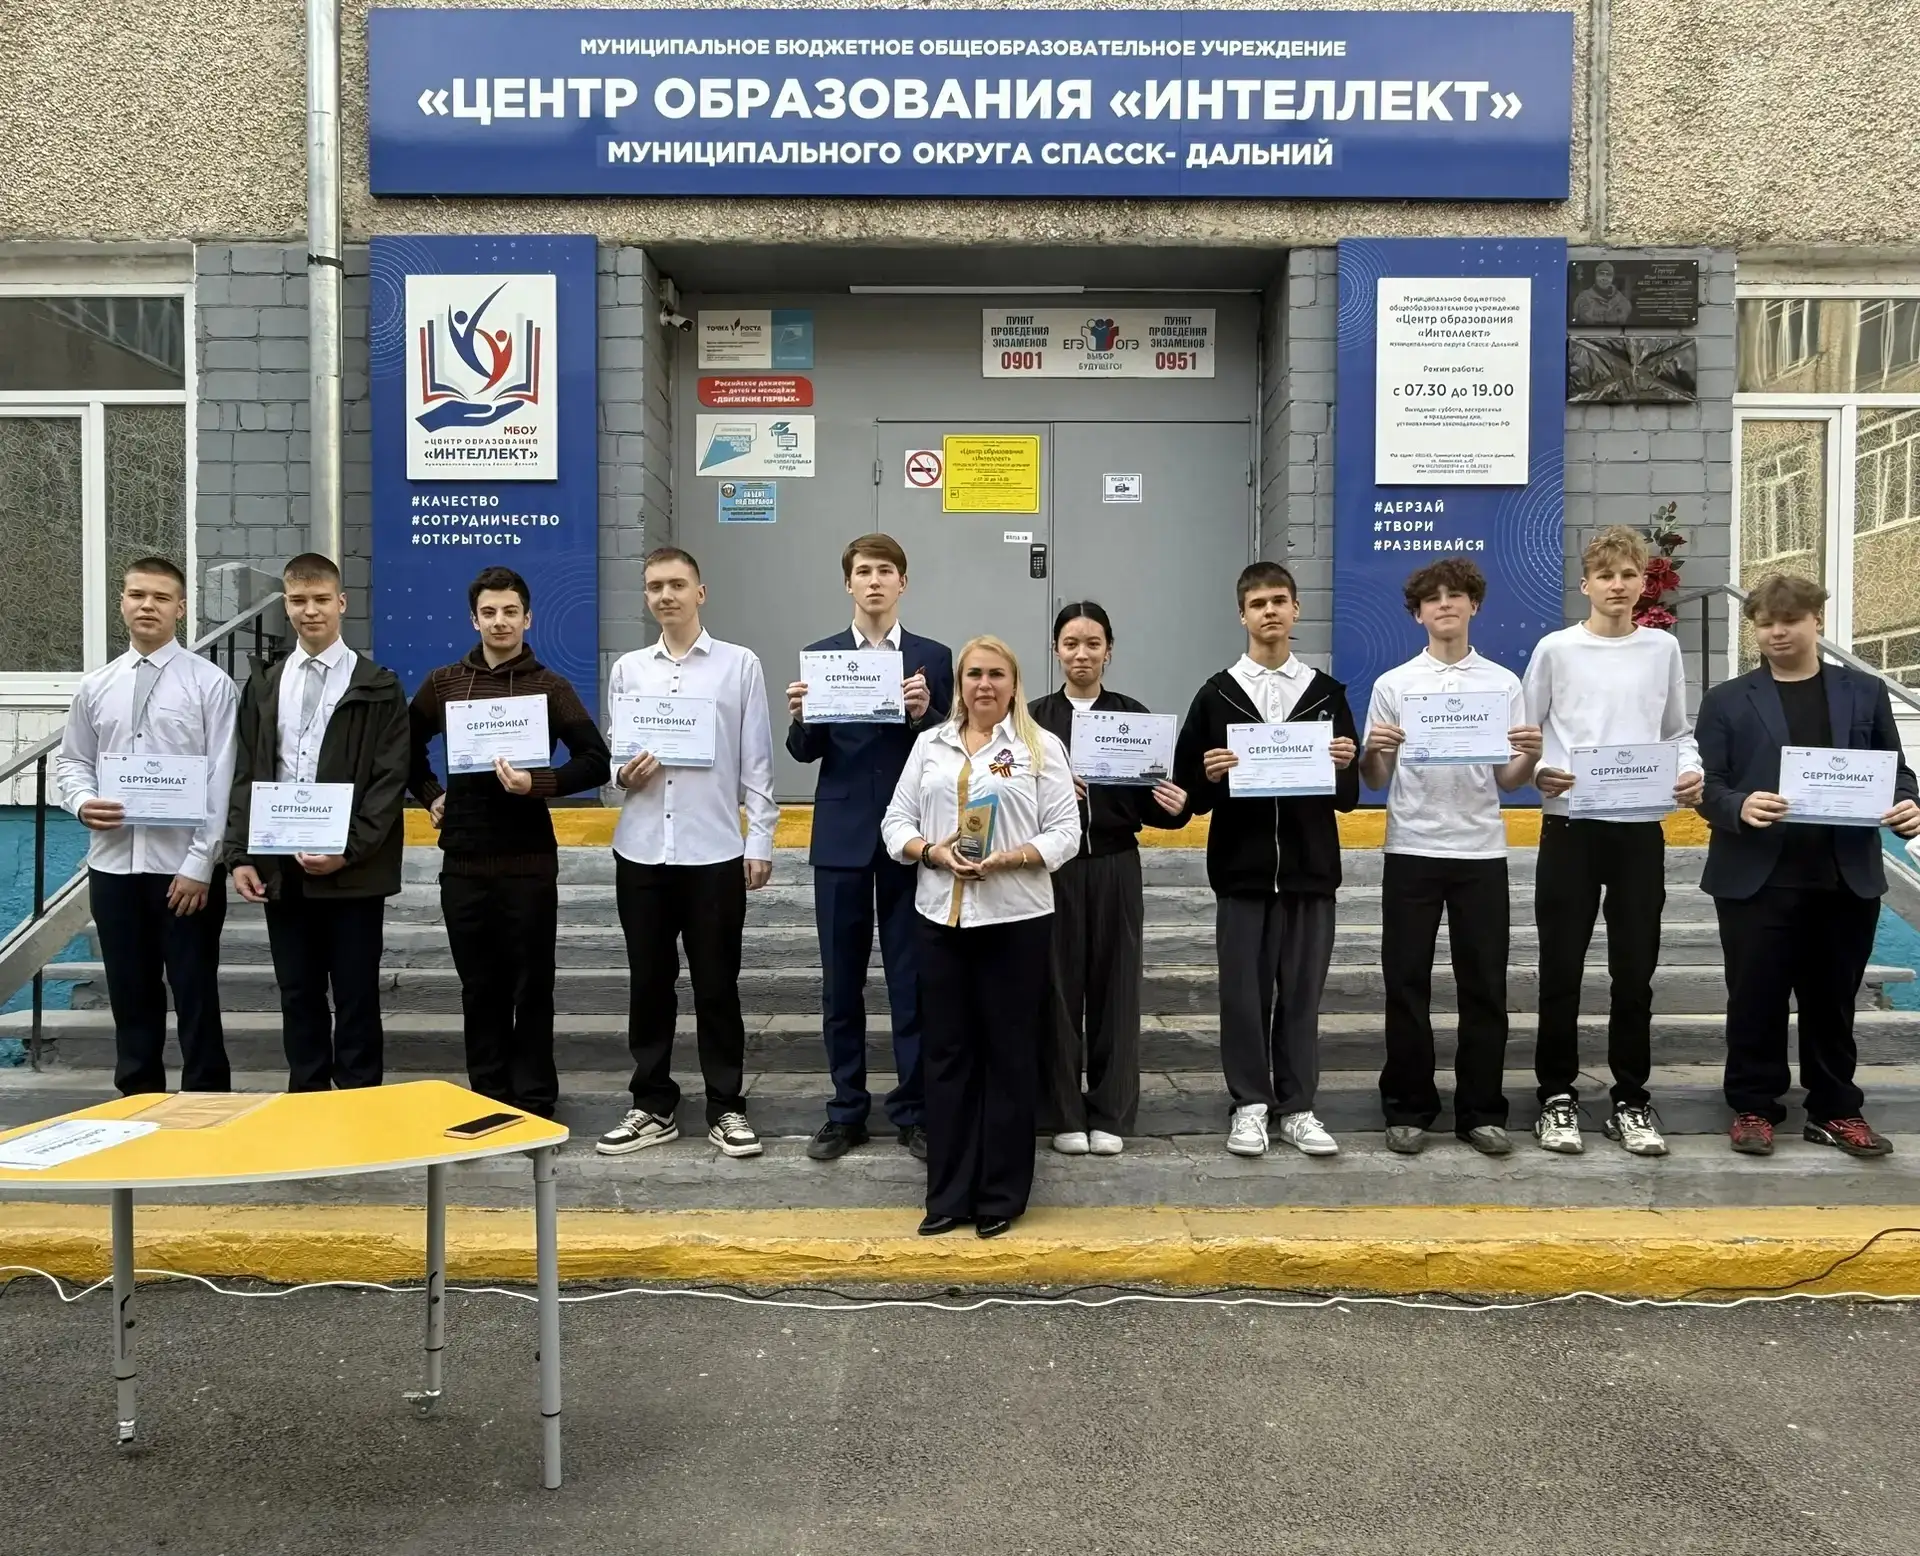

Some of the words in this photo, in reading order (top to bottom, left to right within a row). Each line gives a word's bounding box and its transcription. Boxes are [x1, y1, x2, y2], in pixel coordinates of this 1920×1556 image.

[581, 39, 769, 58] МУНИЦИПАЛЬНОЕ
[775, 39, 914, 58] БЮДЖЕТНОЕ
[919, 39, 1196, 58] ОБЩЕОБРАЗОВАТЕЛЬНОЕ
[1201, 39, 1346, 58] УЧРЕЖДЕНИЕ
[417, 76, 638, 126] «ЦЕНТР
[653, 77, 1093, 120] ОБРАЗОВАНИЯ
[1109, 78, 1524, 122] «ИНТЕЛЛЕКТ»
[607, 140, 902, 167] МУНИЦИПАЛЬНОГО
[912, 141, 1033, 166] ОКРУГА
[1041, 142, 1176, 166] СПАССК-
[1185, 138, 1334, 169] ДАЛЬНИЙ
[1403, 295, 1462, 304] Муниципальное
[1389, 304, 1473, 313] общеобразовательное
[1475, 305, 1520, 313] учреждение
[1006, 316, 1034, 326] ПУНКТ
[1164, 316, 1192, 327] ПУНКТ
[1395, 314, 1437, 325] «Центр
[1440, 313, 1513, 325] образования
[991, 326, 1049, 337] ПРОВЕДЕНИЯ
[1149, 327, 1207, 338] ПРОВЕДЕНИЯ
[1418, 328, 1491, 339] «Интеллект»
[992, 338, 1048, 349] ЭКЗАМЕНОВ
[1063, 339, 1084, 350] ЕГЭ
[1115, 339, 1139, 350] ОГЭ
[1150, 338, 1205, 349] ЭКЗАМЕНОВ
[1001, 351, 1043, 370] 0901
[1086, 352, 1114, 360] ВЫБОР
[1155, 352, 1197, 371] 0951
[1451, 366, 1484, 374] работы:
[1393, 387, 1400, 397] с
[1404, 383, 1447, 397] 07.30
[1450, 387, 1468, 399] до
[1472, 383, 1514, 397] 19.00
[503, 425, 538, 436] МБОУ
[424, 447, 539, 460] «ИНТЕЛЛЕКТ»
[412, 495, 500, 507] #КАЧЕСТВО
[1373, 500, 1445, 514] #ДЕРЗАЙ
[412, 514, 560, 528] #СОТРУДНИЧЕСТВО
[1373, 520, 1434, 532] #ТВОРИ
[412, 533, 522, 546] #ОТКРЫТОСТЬ
[1373, 537, 1485, 551] #РАЗВИВАЙСЯ
[825, 674, 881, 682] СЕРТИФИКАТ
[632, 715, 697, 726] СЕРТИФИКАТ
[1420, 713, 1490, 723] СЕРТИФИКАТ
[466, 718, 529, 730] СЕРТИФИКАТ
[1094, 735, 1152, 745] СЕРТИФИКАТ
[1248, 744, 1314, 754] СЕРТИФИКАТ
[1590, 764, 1660, 776] СЕРТИФИКАТ
[119, 775, 187, 785] СЕРТИФИКАТ
[1802, 771, 1874, 782] СЕРТИФИКАТ
[270, 804, 333, 813] СЕРТИФИКАТ
